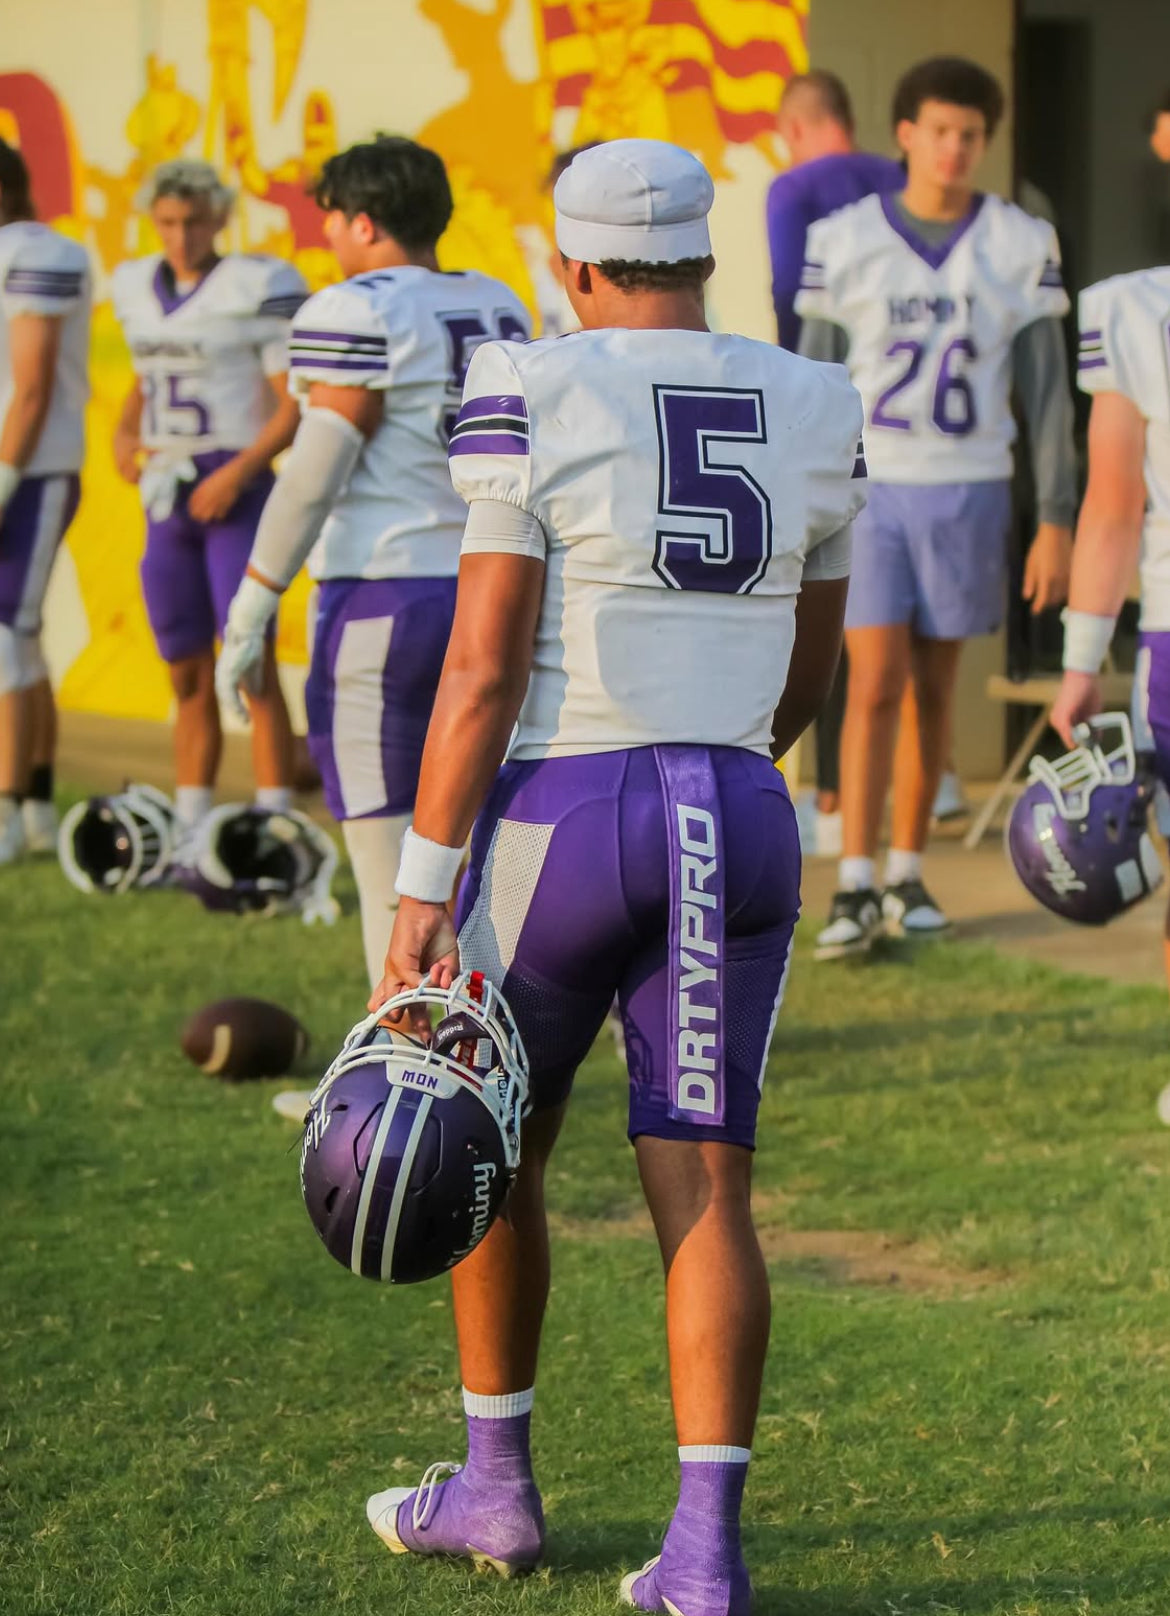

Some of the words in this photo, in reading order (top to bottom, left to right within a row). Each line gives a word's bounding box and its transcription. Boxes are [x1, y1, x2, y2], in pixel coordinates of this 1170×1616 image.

[652, 383, 773, 594] 5
[871, 337, 977, 434] 26
[676, 803, 718, 1114] DRTYPRO
